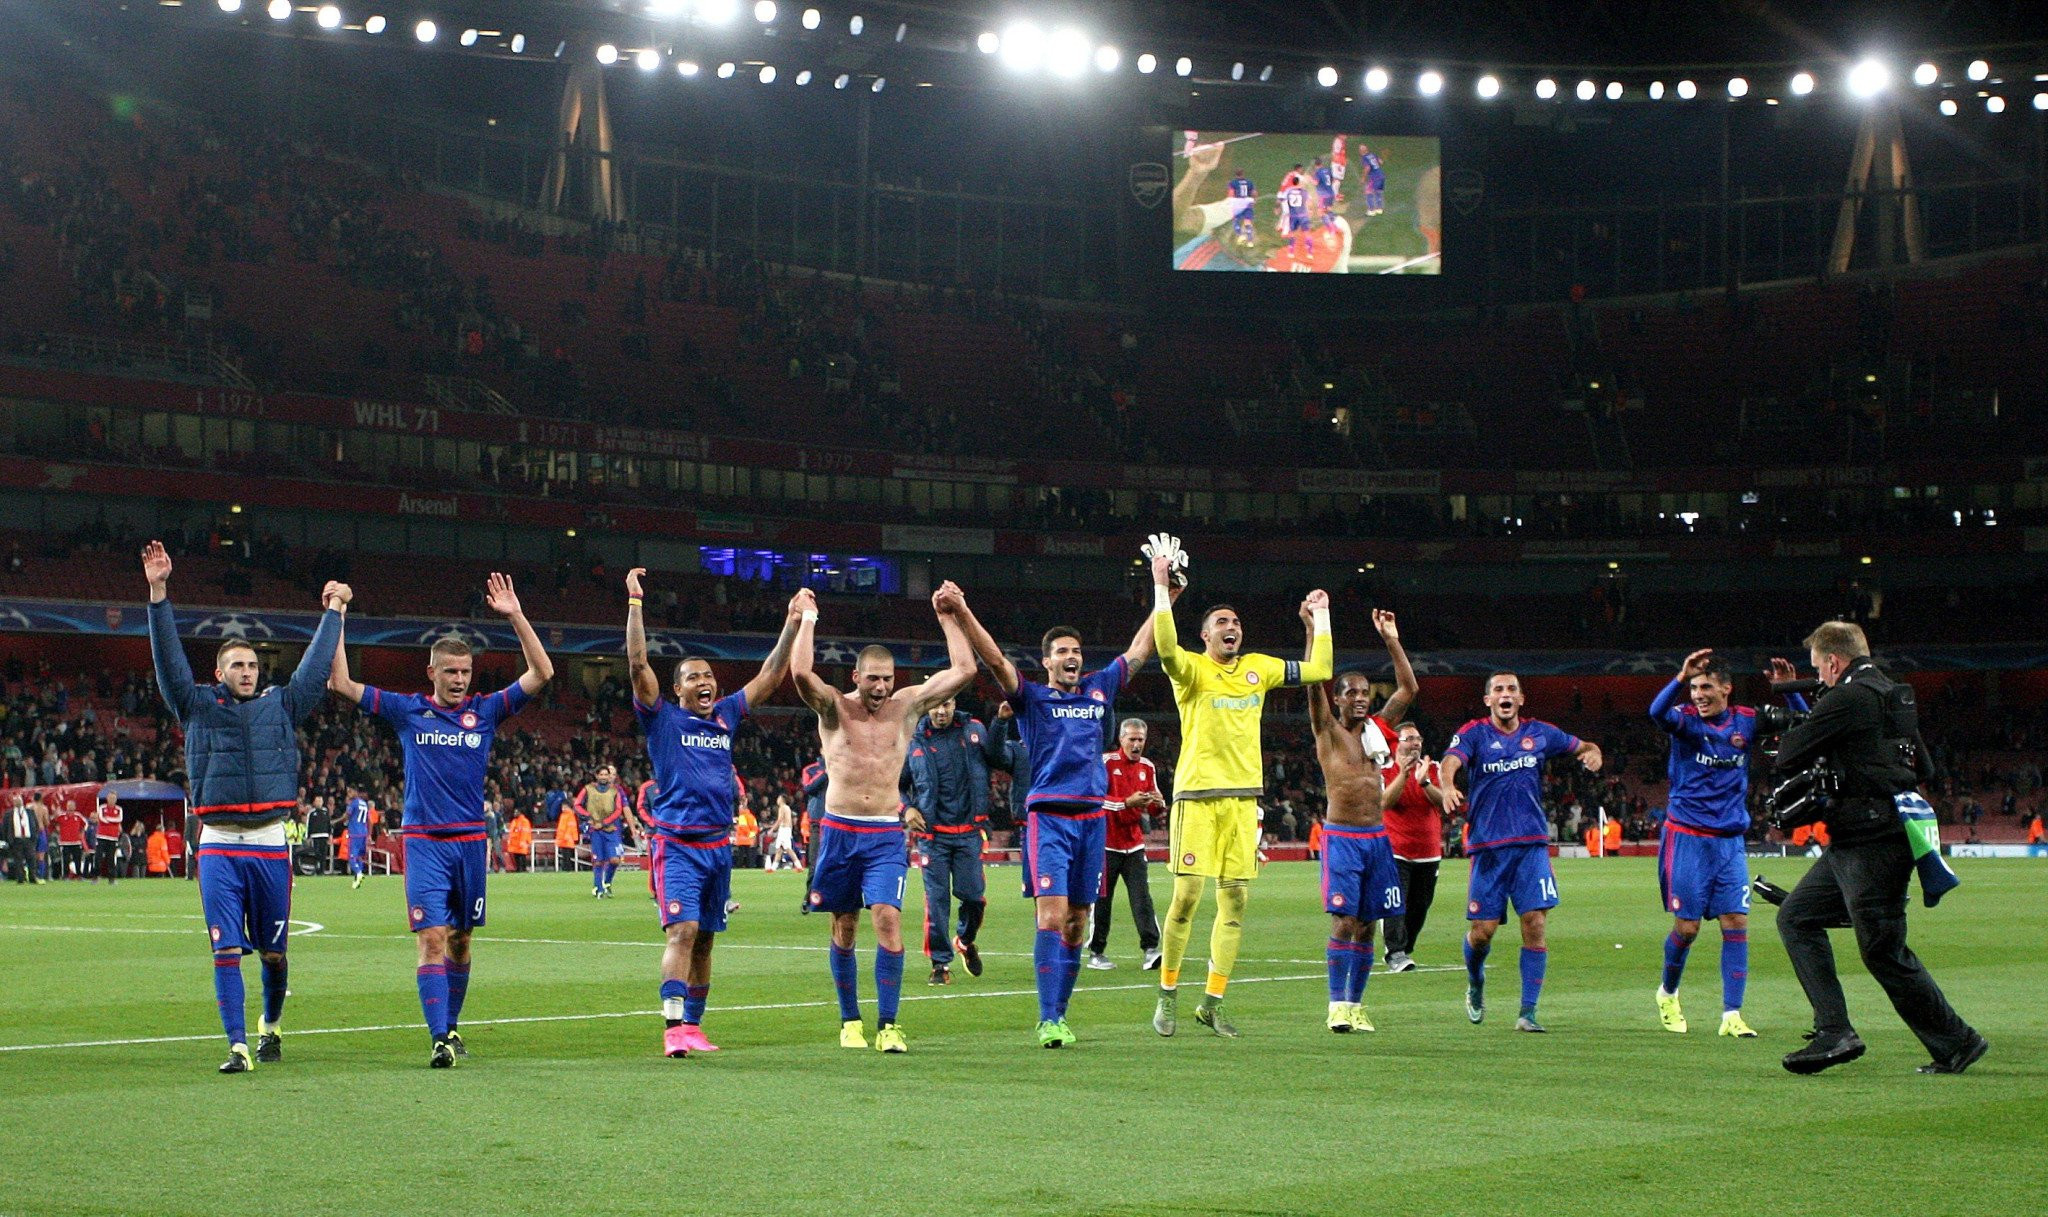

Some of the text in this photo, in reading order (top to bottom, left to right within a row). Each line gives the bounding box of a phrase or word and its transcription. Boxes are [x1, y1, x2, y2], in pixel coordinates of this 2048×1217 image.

[218, 392, 265, 416] 1971
[353, 400, 440, 433] WHL 71
[539, 424, 579, 445] 1971
[397, 492, 459, 516] Arsenal
[1043, 537, 1105, 556] Arsenal
[1051, 704, 1095, 719] unicef
[415, 729, 465, 747] unicef
[1482, 757, 1524, 773] unicef
[357, 805, 368, 824] 77
[1384, 886, 1402, 909] 30
[1539, 876, 1558, 901] 14
[472, 897, 484, 921] 9
[271, 920, 285, 944] 7
